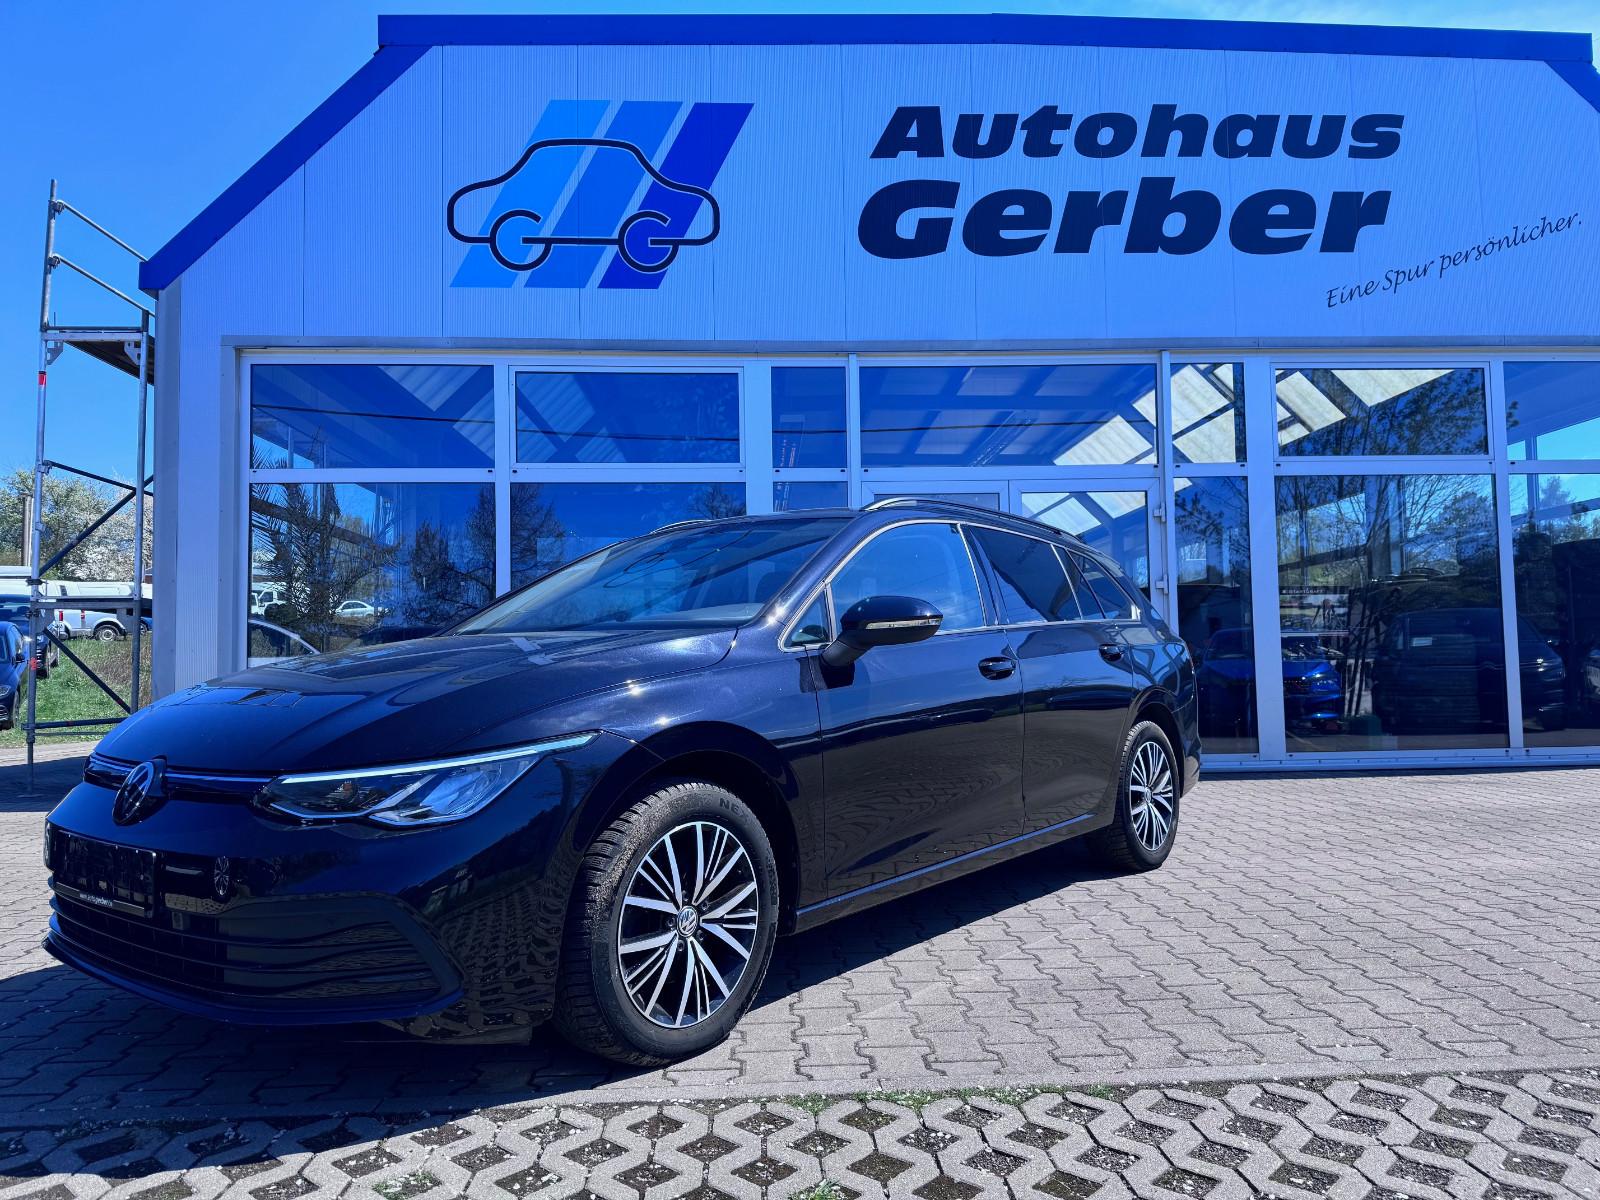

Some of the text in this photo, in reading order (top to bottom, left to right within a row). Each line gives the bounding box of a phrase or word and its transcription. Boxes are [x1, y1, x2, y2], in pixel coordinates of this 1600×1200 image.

[870, 104, 1404, 159] Autohaus
[857, 177, 1392, 260] Gerber
[1326, 212, 1582, 308] Eine Spur persönlicher.
